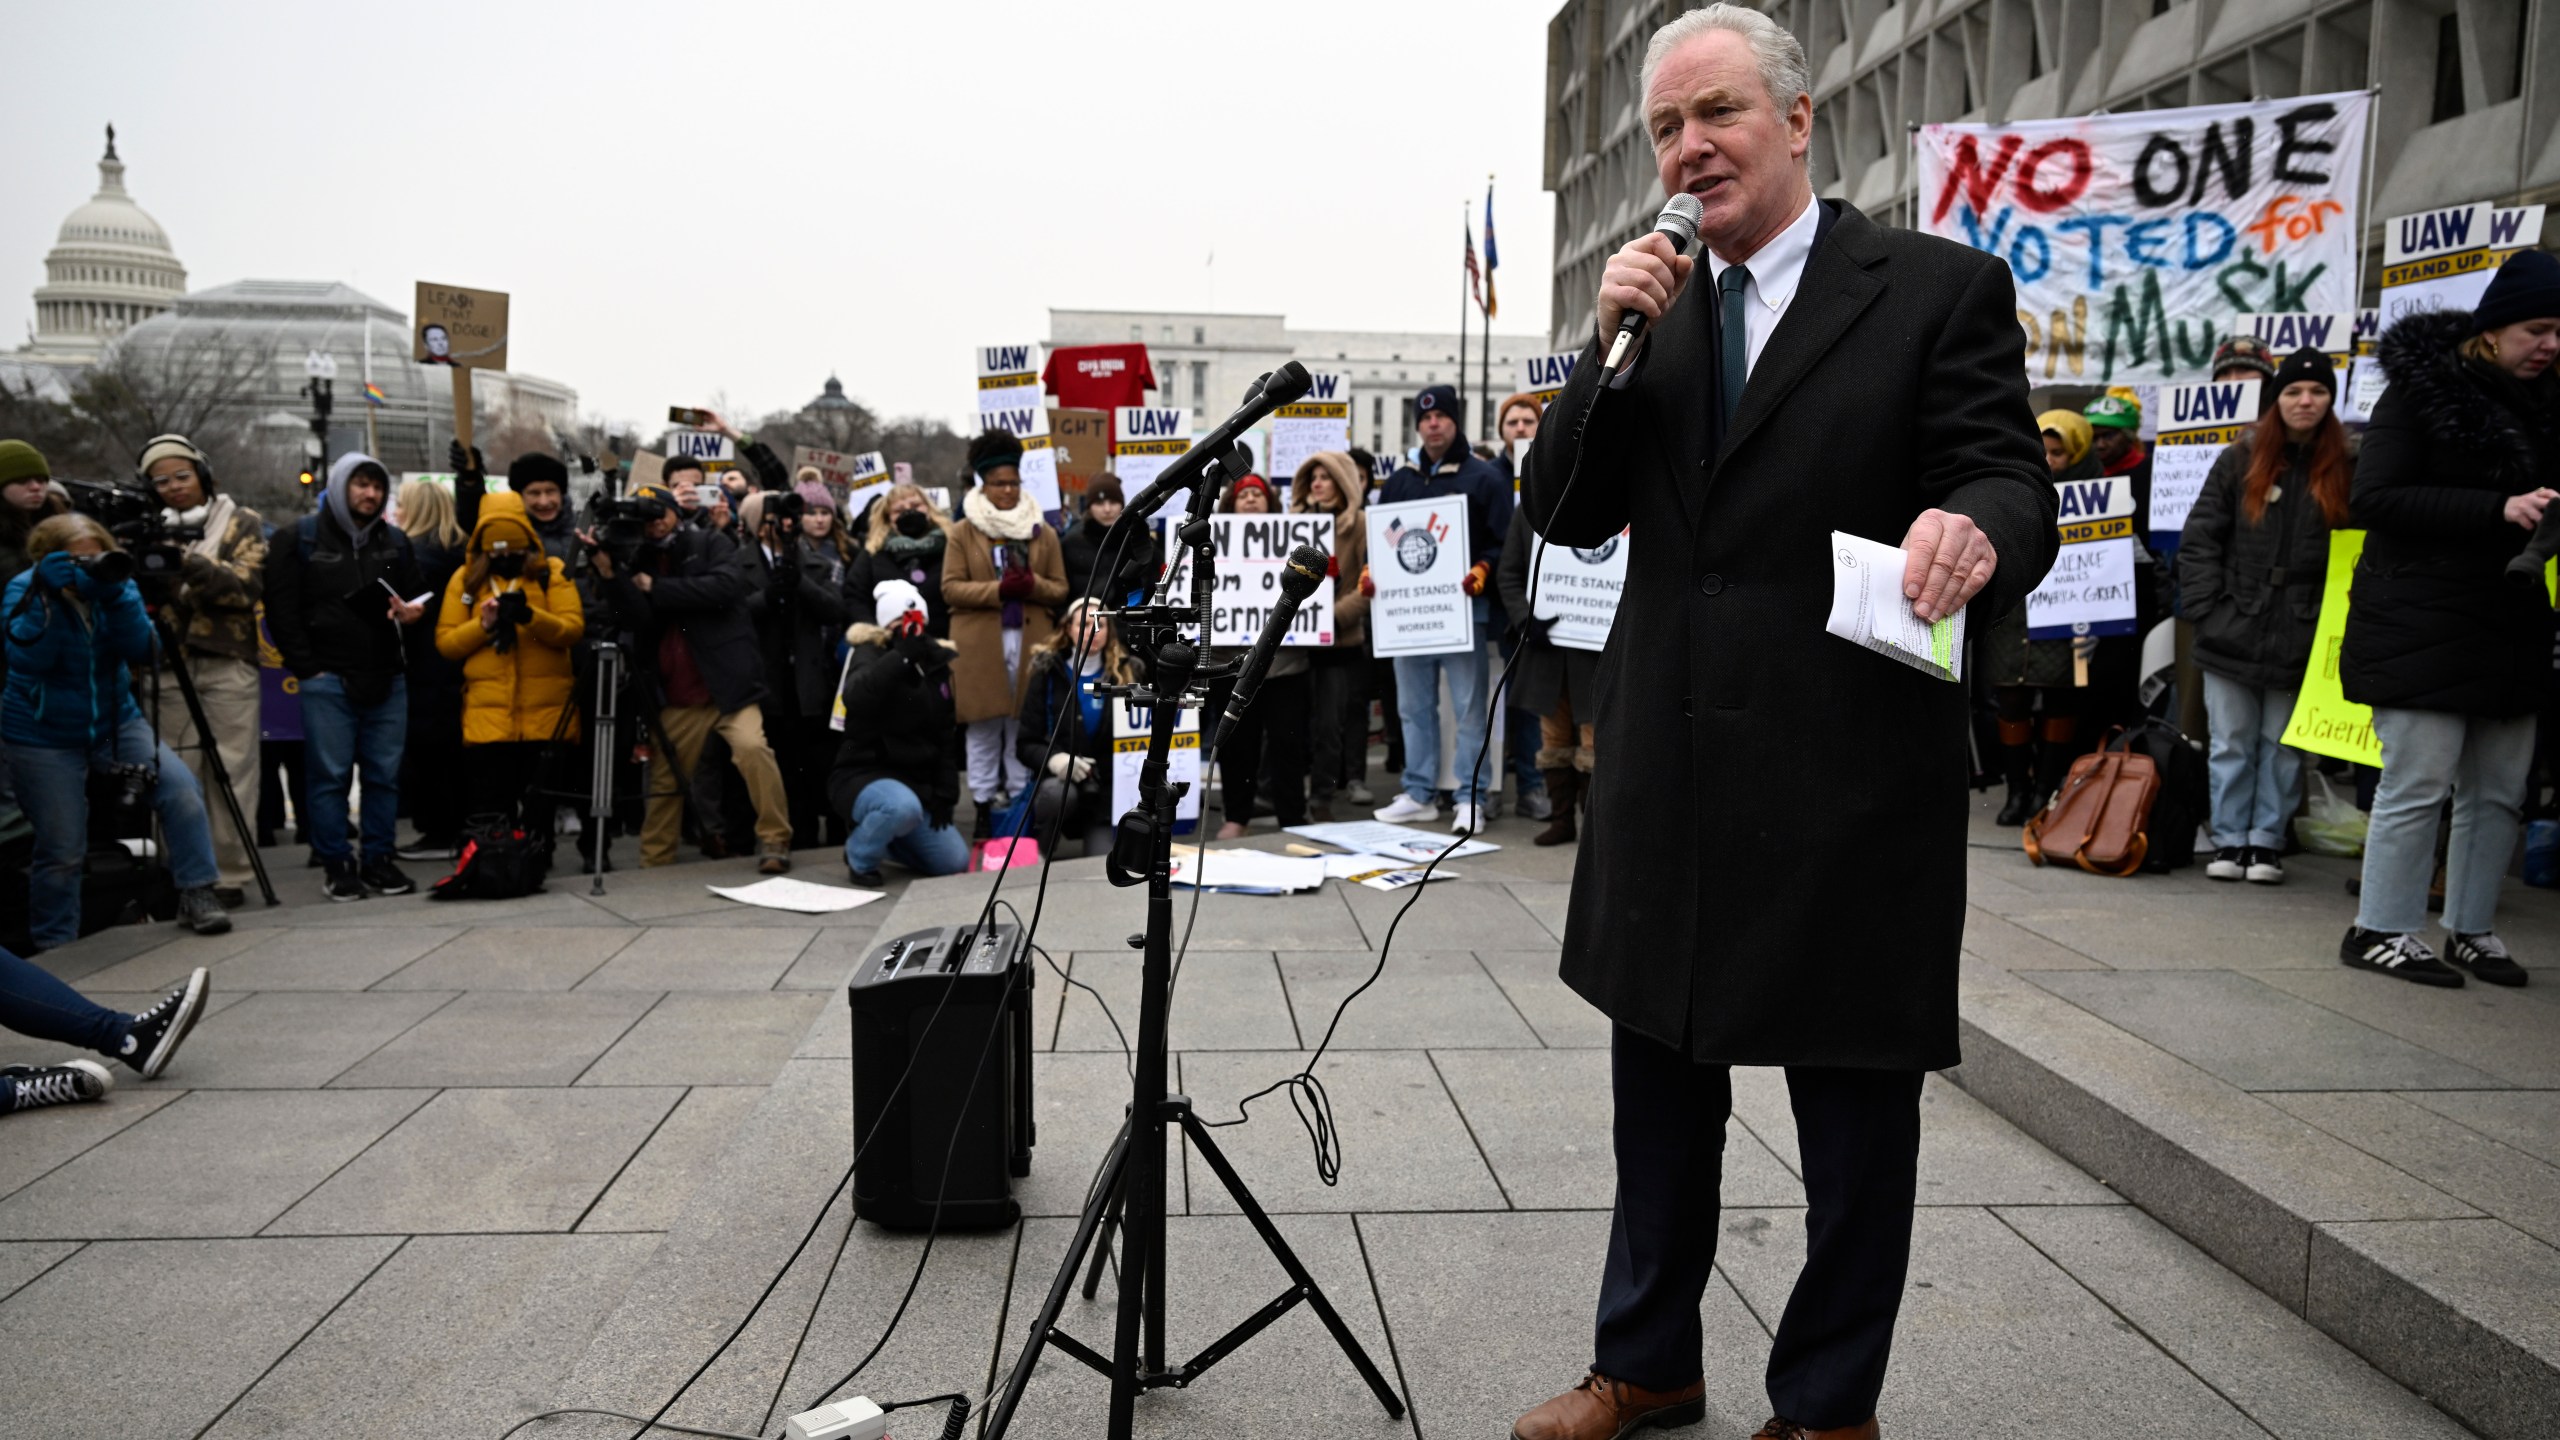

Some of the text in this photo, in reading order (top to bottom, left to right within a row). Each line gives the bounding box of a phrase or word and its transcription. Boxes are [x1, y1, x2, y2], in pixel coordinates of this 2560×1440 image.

[1932, 102, 2337, 225] NO ONE
[2401, 208, 2475, 254] UAW
[1960, 195, 2344, 291] VOTED for
[2389, 261, 2450, 284] STAND
[2456, 253, 2484, 269] UP
[2253, 315, 2334, 349] UAW
[986, 346, 1028, 371] UAW
[981, 376, 1036, 389] STAND UP
[1278, 406, 1344, 415] STAND UP
[2174, 384, 2244, 422] UAW
[982, 408, 1034, 434] UAW
[1051, 417, 1106, 438] IGHT
[1129, 410, 1180, 435] UAW
[678, 435, 723, 457] UAW
[1028, 438, 1047, 450] UP
[1121, 443, 1188, 454] STAND UP
[2059, 481, 2112, 518] AW
[1243, 519, 1332, 561] MUSK
[2101, 522, 2127, 536] UP
[1380, 583, 1458, 600] IFPTE STANDS
[1542, 572, 1625, 592] IFPTE STAND
[2083, 581, 2133, 603] GREAT
[1545, 592, 1574, 605] WITH
[1386, 604, 1455, 617] WITH FEDERAL
[1397, 621, 1445, 633] WORKERS
[1174, 736, 1195, 748] UP
